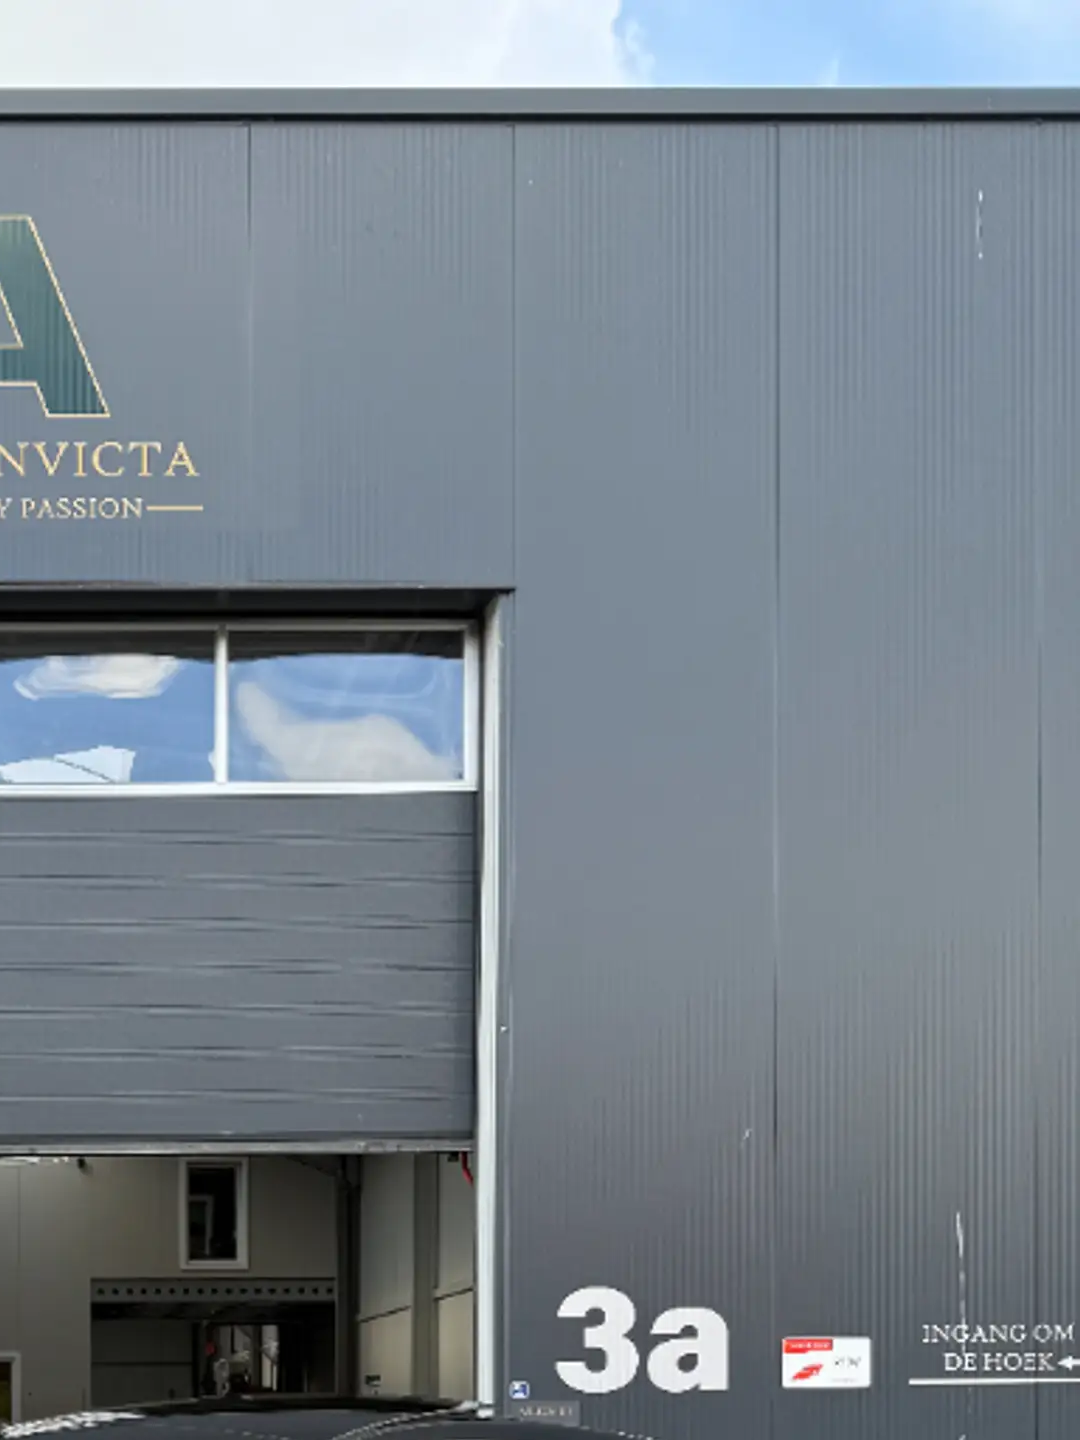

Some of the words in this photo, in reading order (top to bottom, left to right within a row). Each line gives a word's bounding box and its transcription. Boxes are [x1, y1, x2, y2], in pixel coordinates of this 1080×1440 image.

[20, 497, 143, 519] PASSION
[555, 1285, 730, 1394] 3a
[922, 1323, 1027, 1344] INGANG
[1033, 1322, 1076, 1344] OM
[943, 1352, 978, 1372] DE
[983, 1352, 1057, 1372] HOEK
